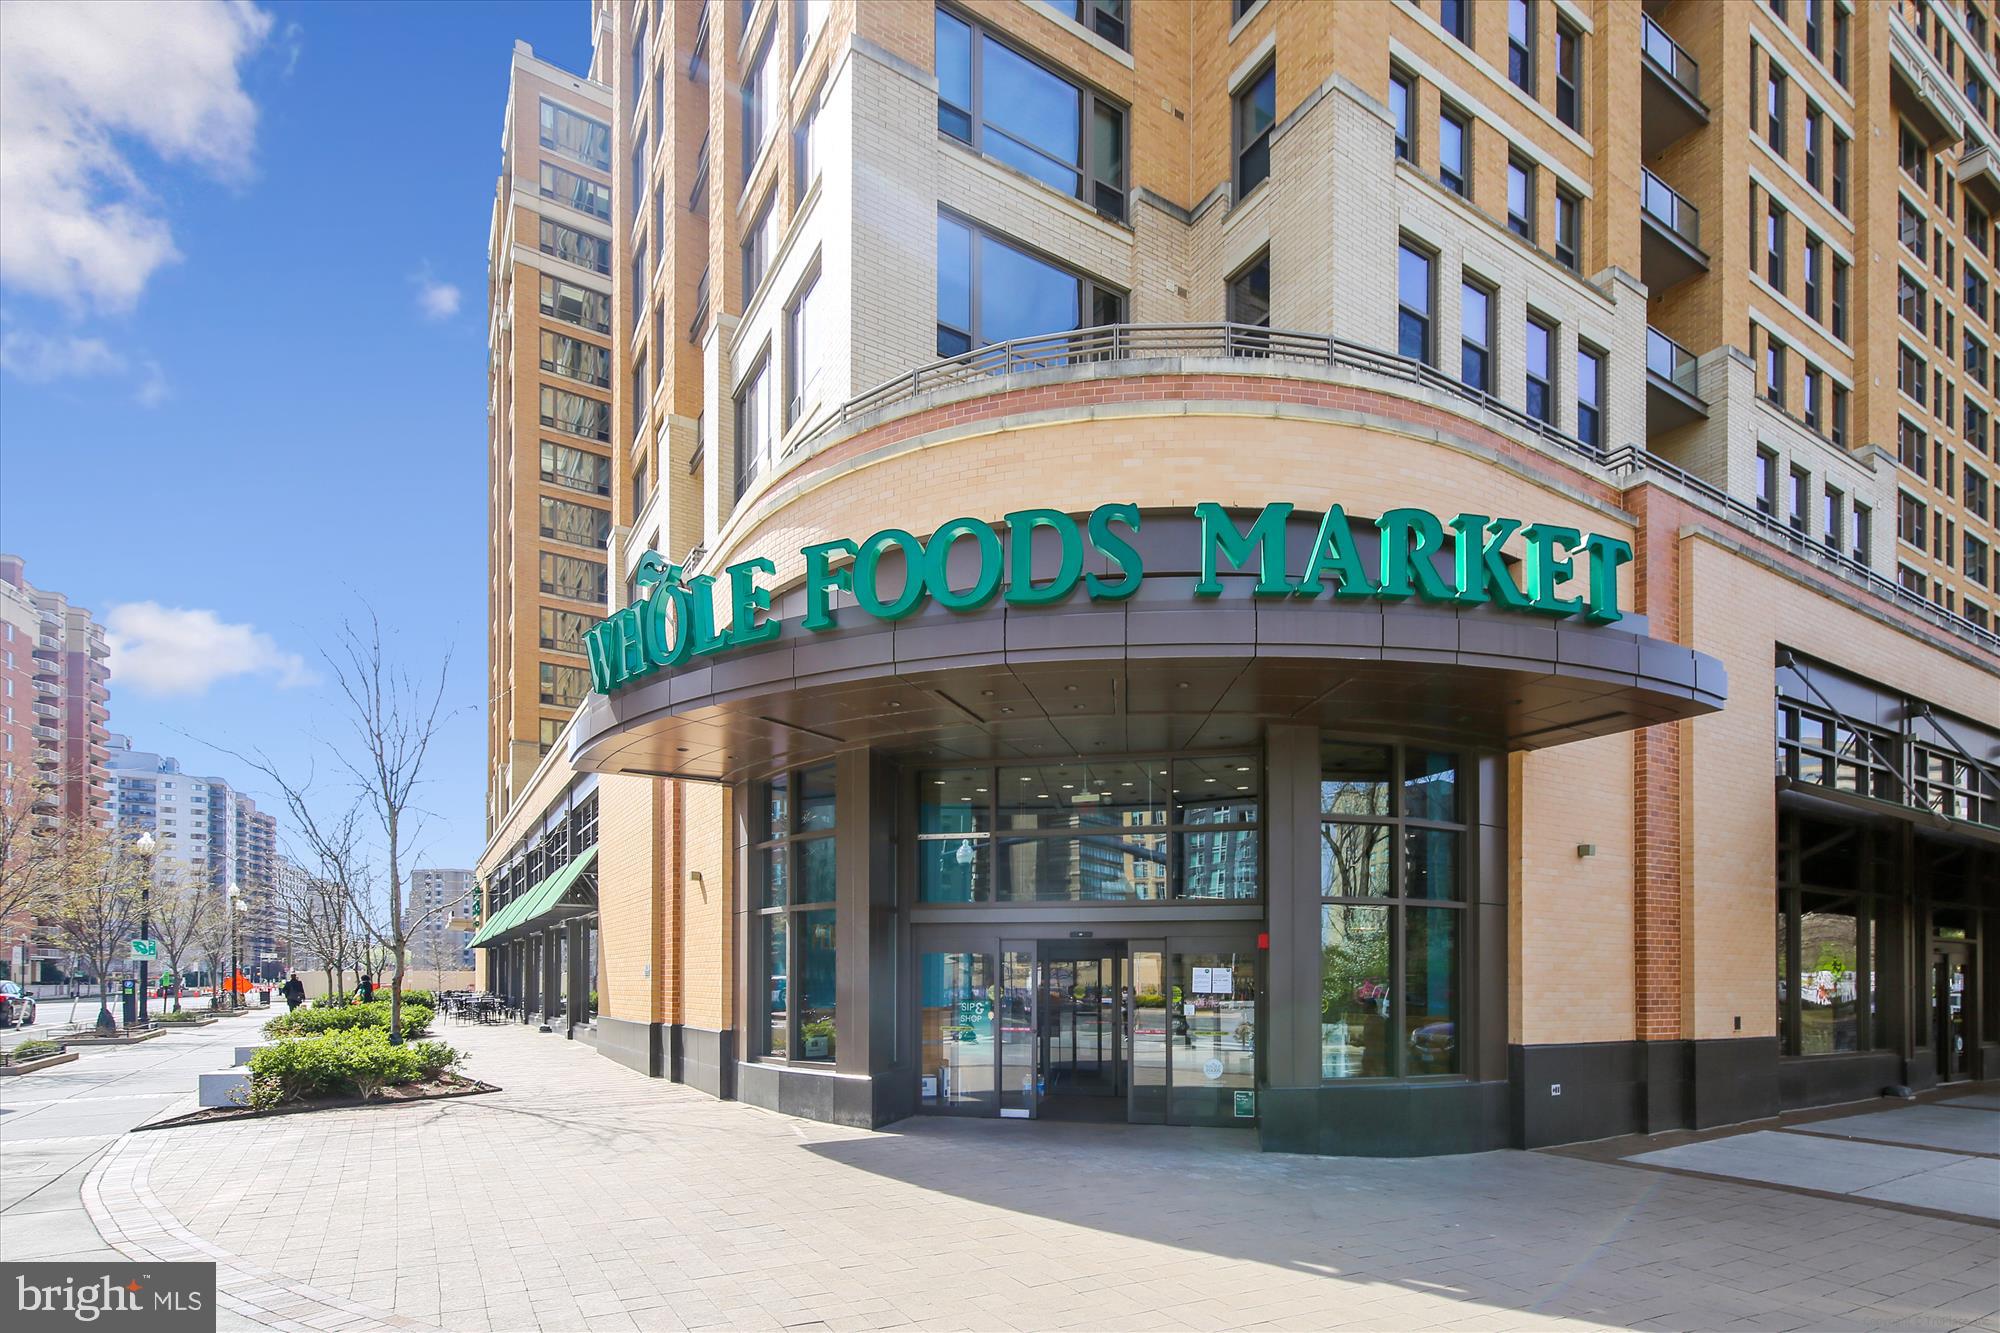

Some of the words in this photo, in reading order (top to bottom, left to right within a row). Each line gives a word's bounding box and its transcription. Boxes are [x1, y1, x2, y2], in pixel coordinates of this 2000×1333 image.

[582, 555, 780, 695] WHOLE
[800, 502, 1143, 632] FOODS
[1194, 502, 1634, 625] MARKET
[960, 1014, 982, 1022] SHOP
